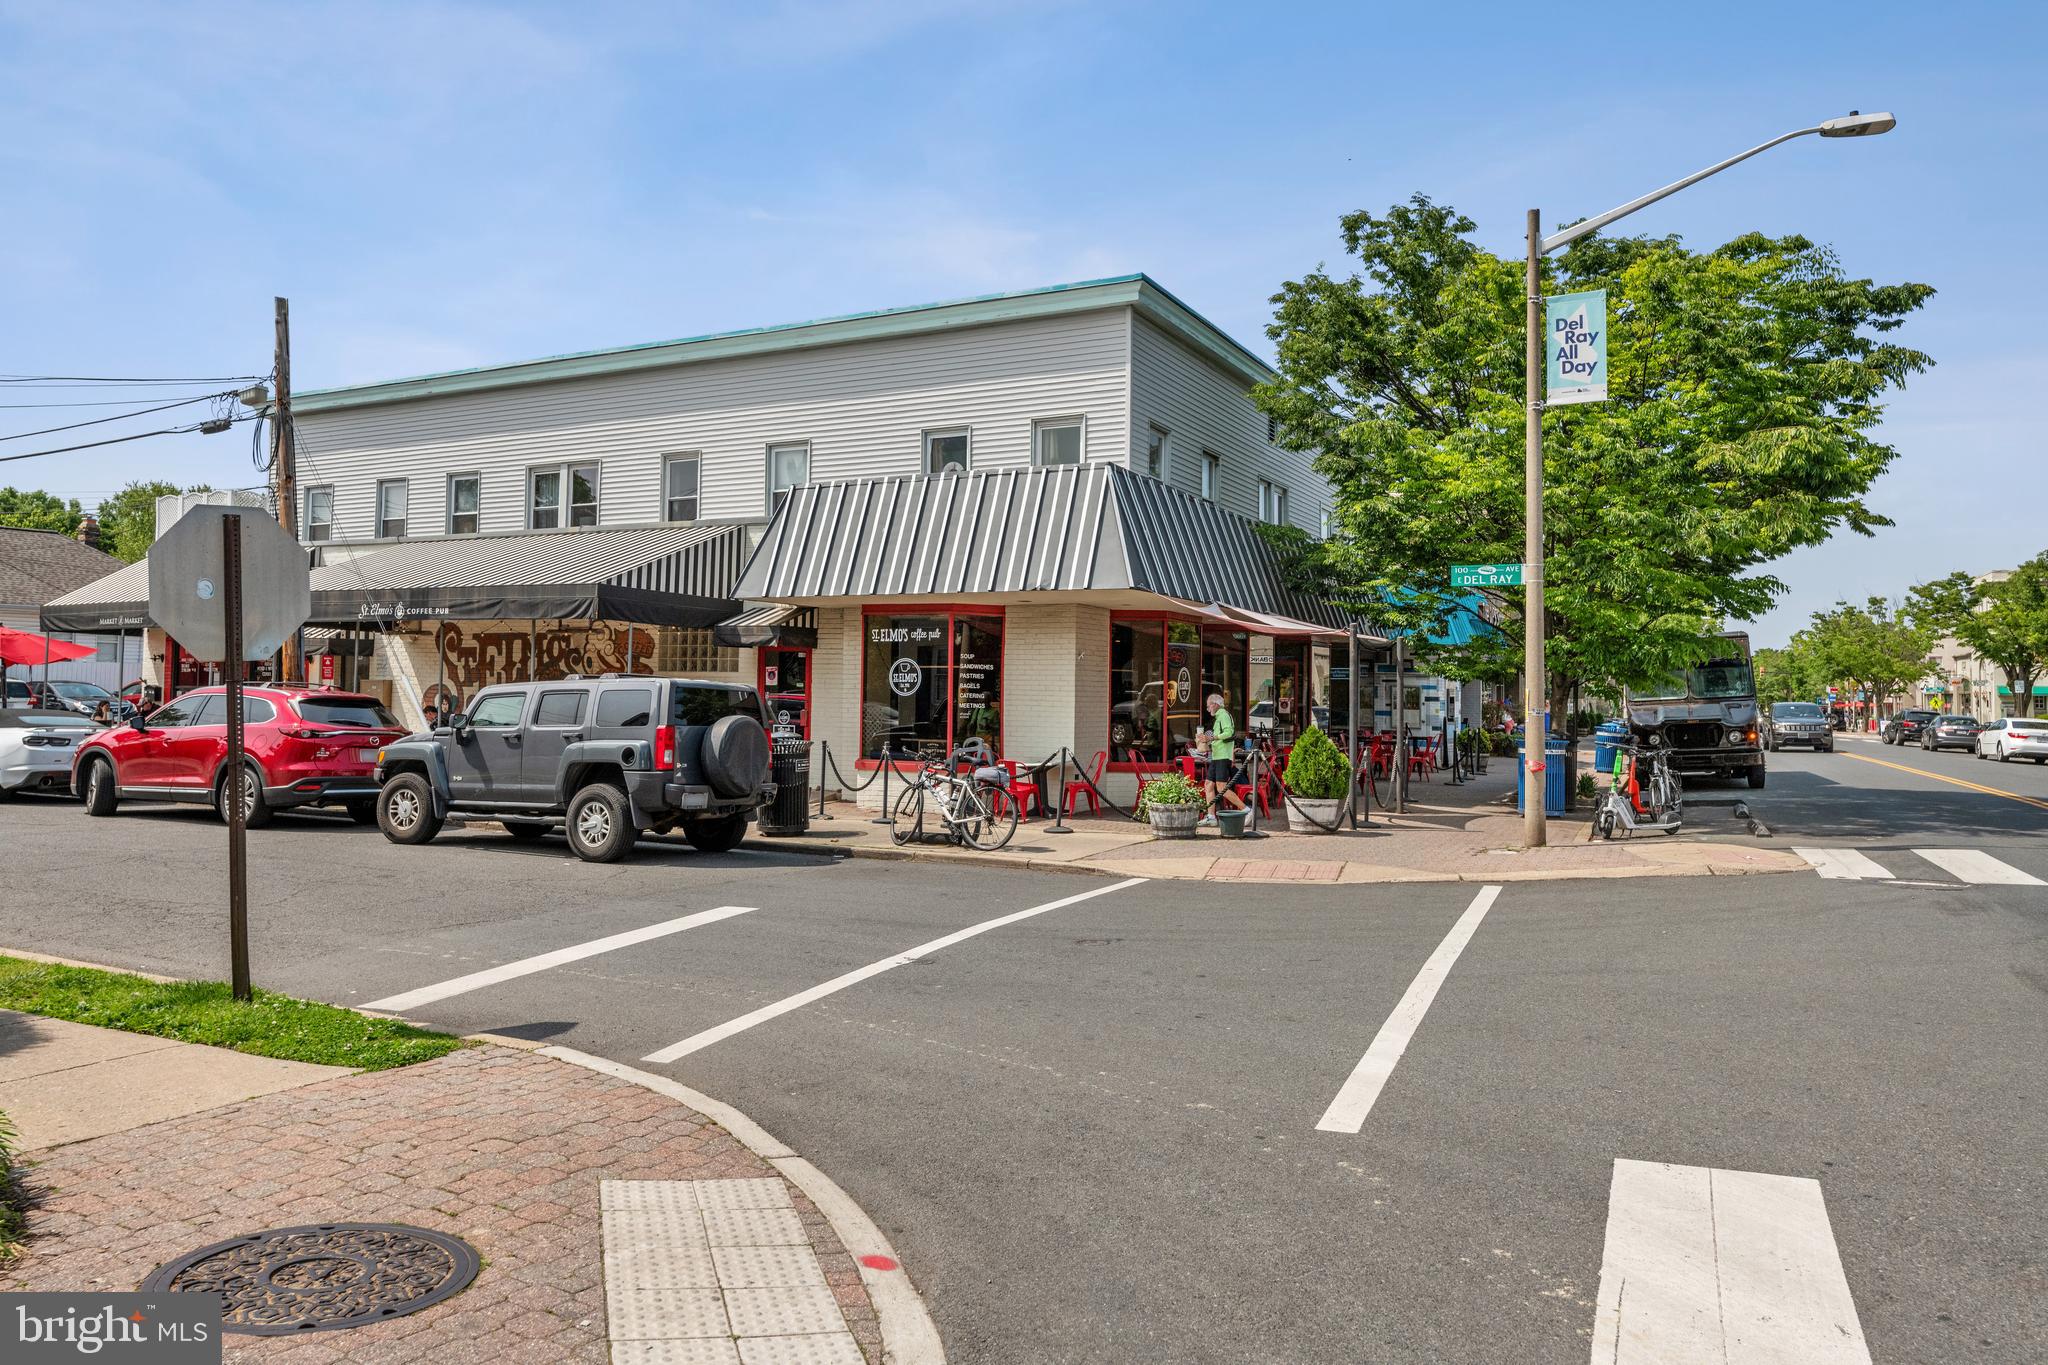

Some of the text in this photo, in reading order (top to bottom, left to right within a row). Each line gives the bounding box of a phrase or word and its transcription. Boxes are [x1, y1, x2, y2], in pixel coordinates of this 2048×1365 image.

[1556, 315, 1584, 332] Del
[1565, 331, 1599, 346] Ray
[1556, 344, 1578, 361] All
[1562, 361, 1598, 376] Day
[1464, 575, 1486, 585] DEL
[1490, 574, 1513, 584] RAY
[370, 603, 394, 616] Elmo's
[406, 607, 432, 615] COFFEE
[880, 628, 909, 642] ELMO'S
[910, 628, 928, 641] coffee
[928, 628, 941, 641] pub
[960, 663, 994, 671] SANDWICHES
